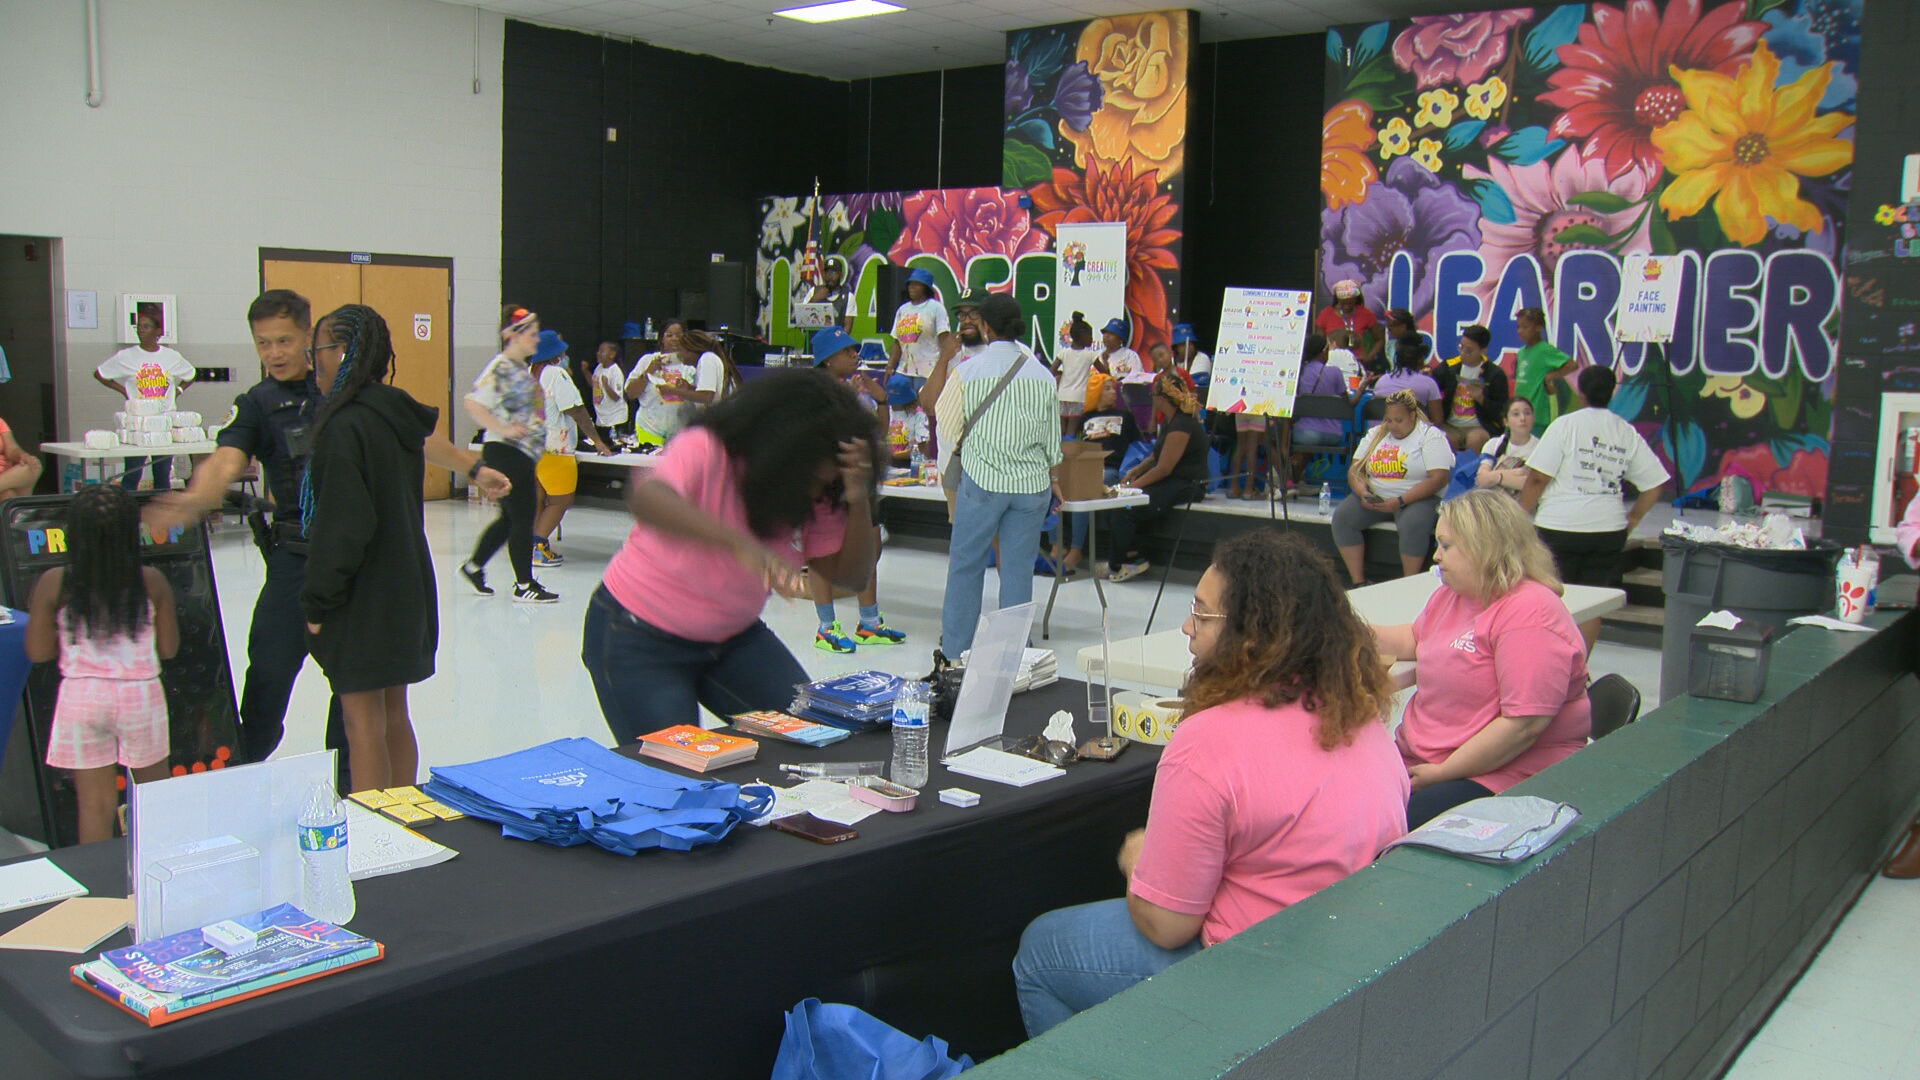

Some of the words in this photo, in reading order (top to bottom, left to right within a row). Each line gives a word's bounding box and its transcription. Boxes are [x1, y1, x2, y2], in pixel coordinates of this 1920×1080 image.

[353, 254, 370, 262] STORAGE
[1087, 260, 1117, 273] CREATIVE
[1637, 290, 1660, 301] FACE
[1628, 302, 1666, 313] PAINTING
[1449, 638, 1476, 653] NES
[125, 951, 164, 980] GIRLS
